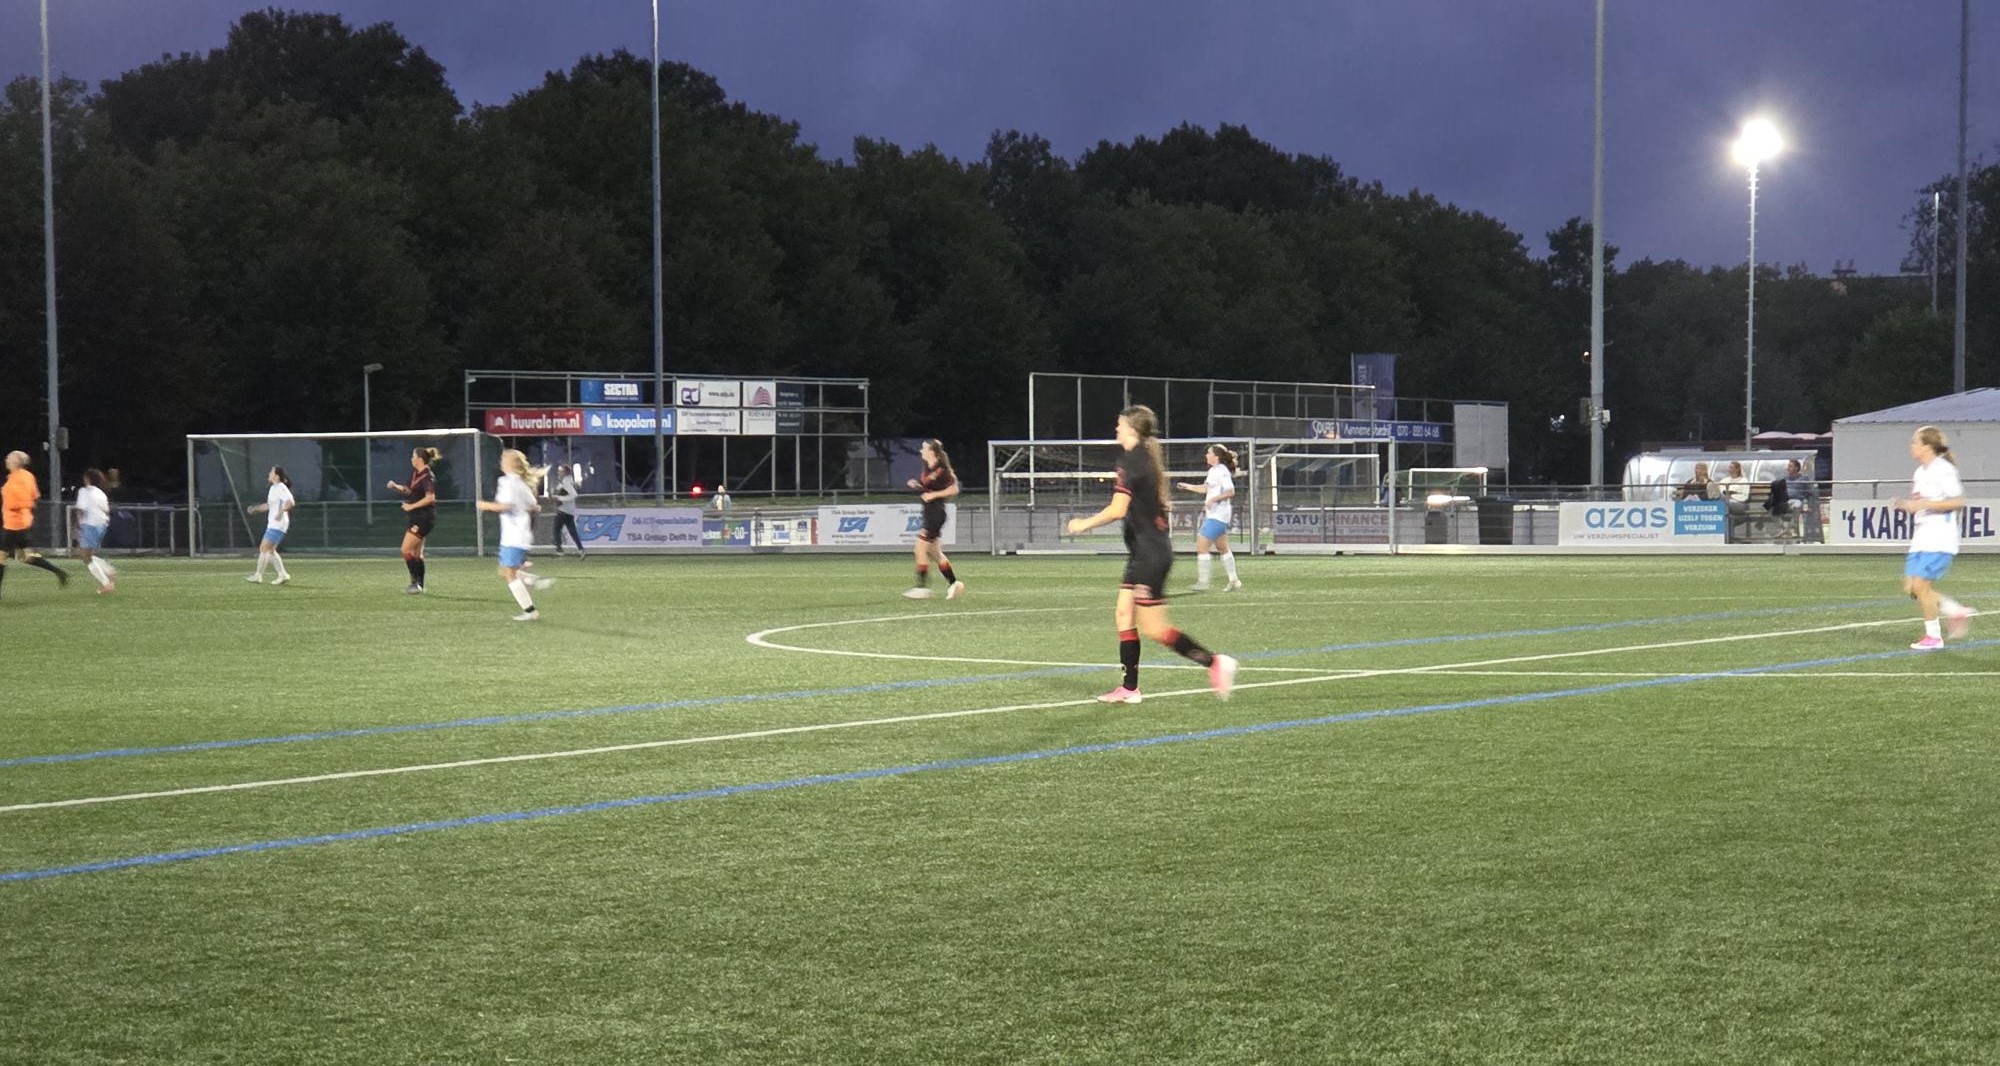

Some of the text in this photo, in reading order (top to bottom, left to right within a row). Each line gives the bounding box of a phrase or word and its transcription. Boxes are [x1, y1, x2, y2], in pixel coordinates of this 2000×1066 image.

[510, 413, 580, 429] huuralarm.nl
[606, 413, 672, 433] koopalarmnl
[1585, 506, 1669, 529] azas
[626, 533, 642, 541] TSA
